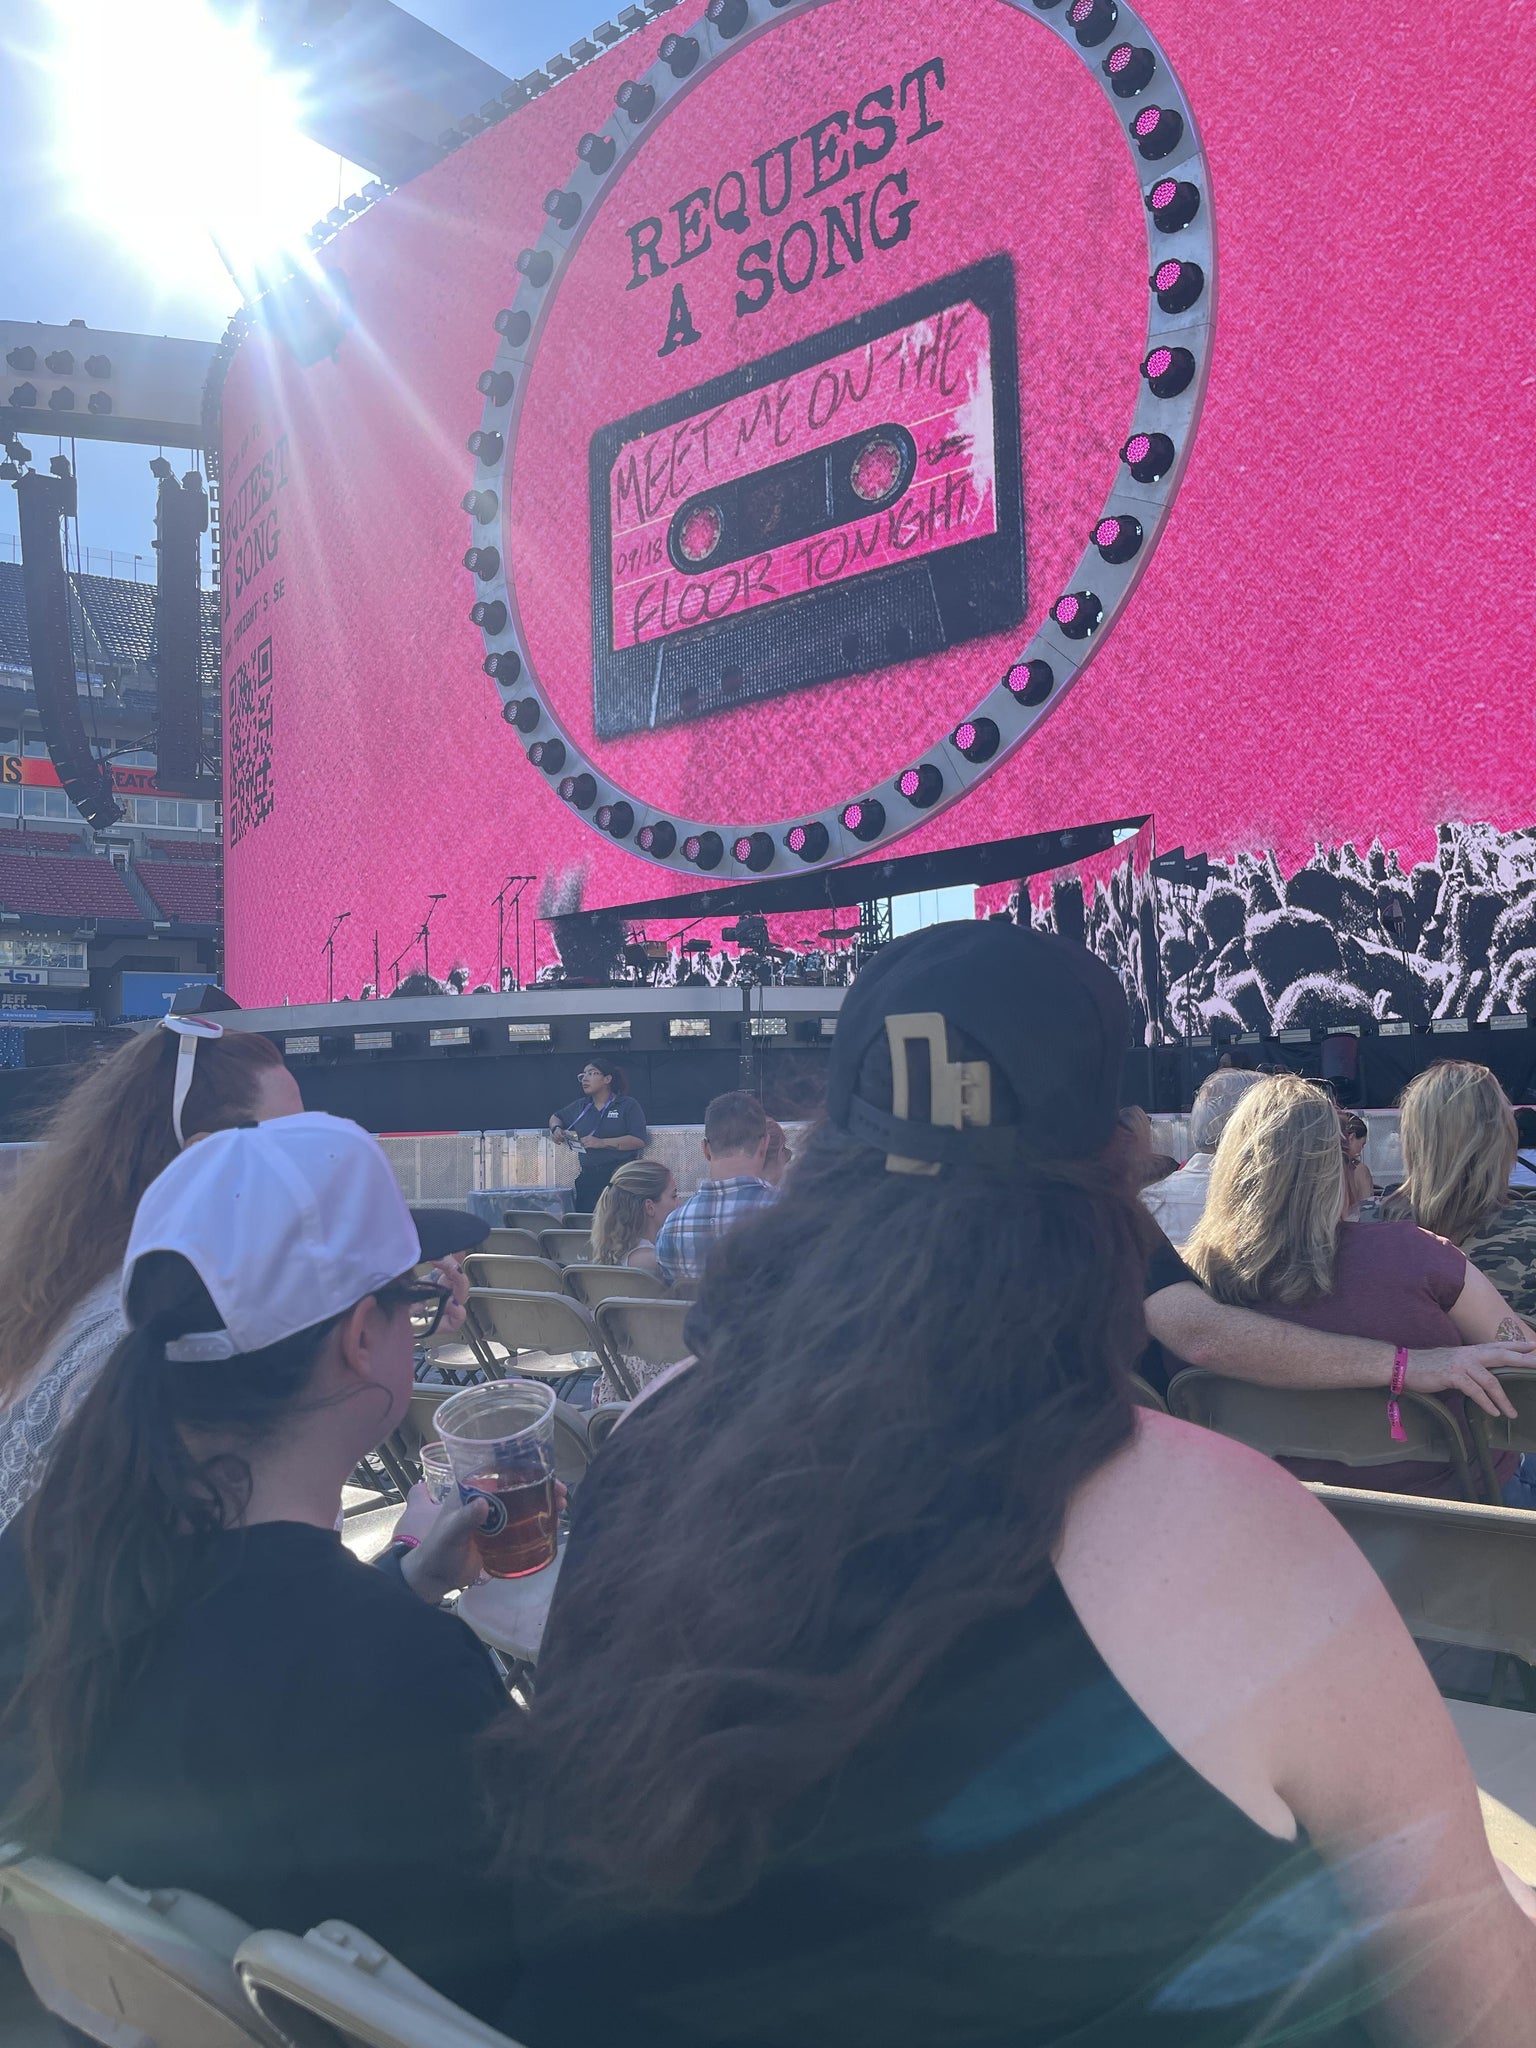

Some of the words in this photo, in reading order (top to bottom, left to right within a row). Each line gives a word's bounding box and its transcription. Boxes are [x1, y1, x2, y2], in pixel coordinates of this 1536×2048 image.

[625, 57, 945, 291] REQUEST
[657, 283, 702, 357] A
[736, 168, 920, 317] SONG
[617, 408, 727, 525] MEET
[735, 379, 797, 458] ME
[807, 344, 875, 431] ON
[885, 309, 970, 396] THE
[235, 508, 281, 599] SONG
[616, 537, 664, 576] 09/18
[633, 555, 778, 645] FLOOR
[790, 471, 974, 590] TONIGHT
[2, 993, 28, 1004] JEFF
[4, 970, 40, 983] tsu
